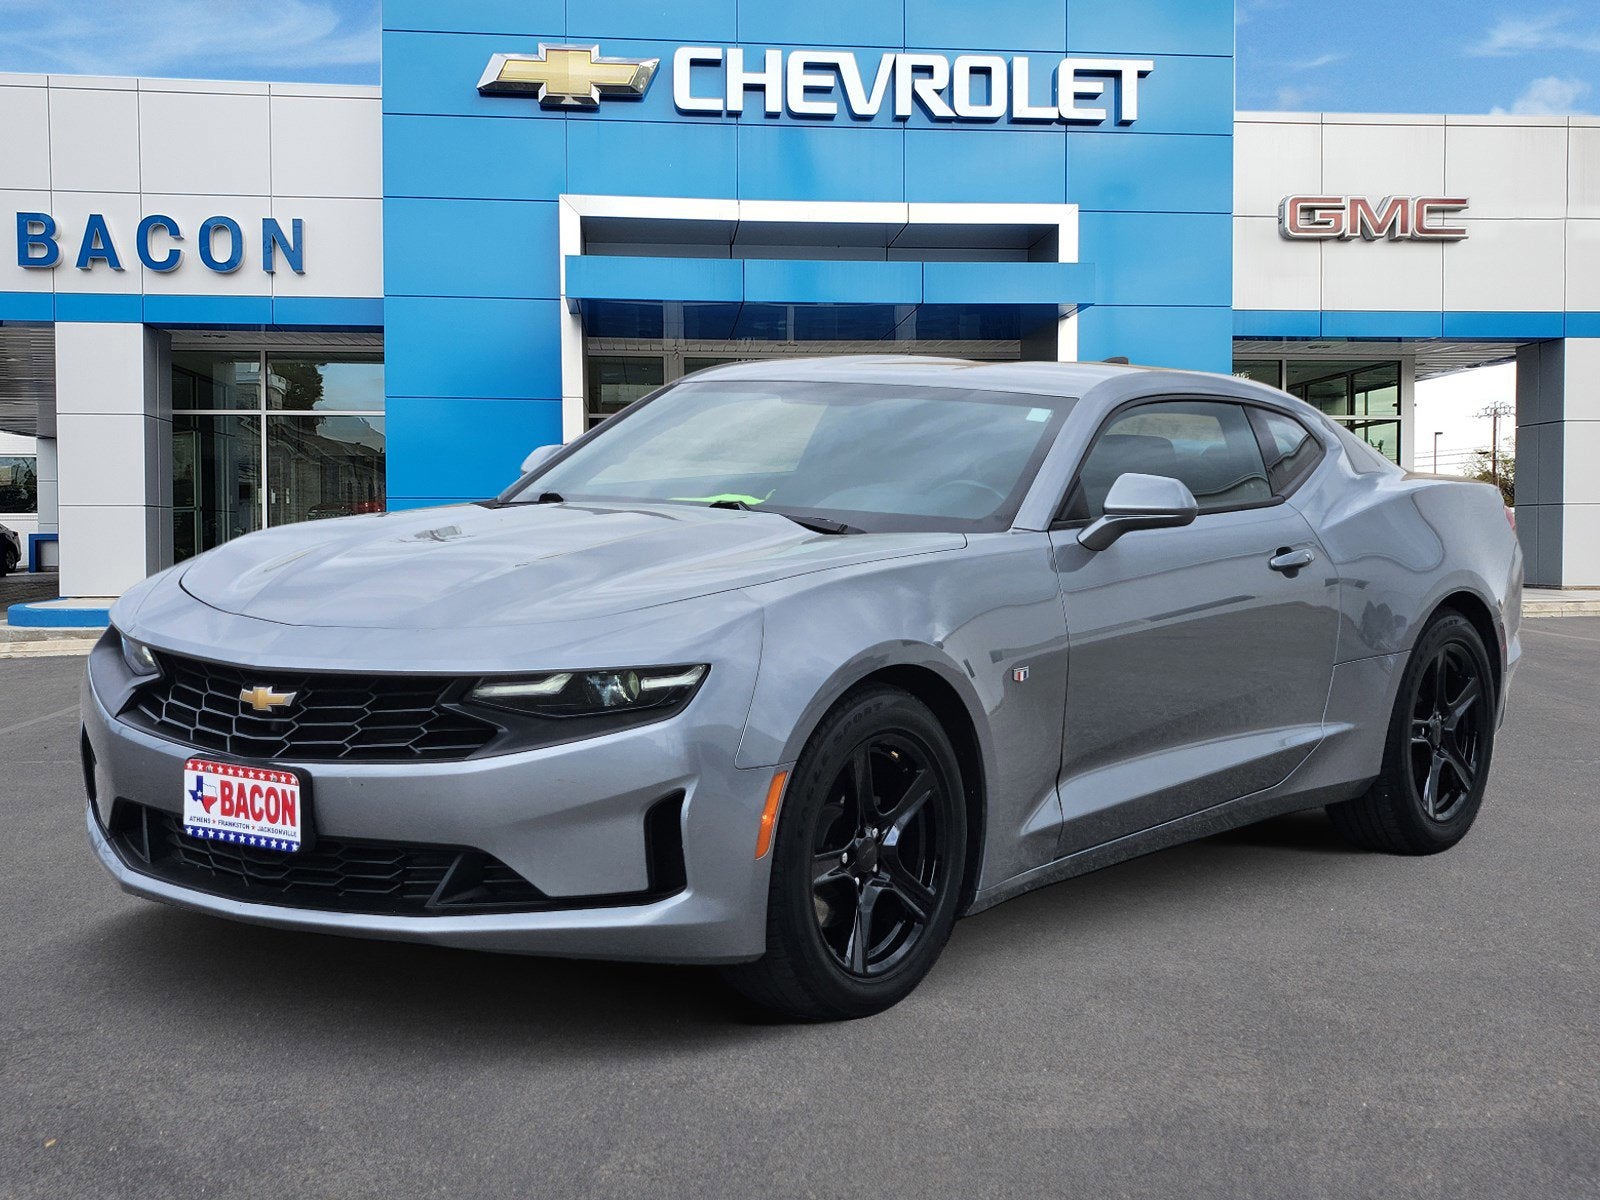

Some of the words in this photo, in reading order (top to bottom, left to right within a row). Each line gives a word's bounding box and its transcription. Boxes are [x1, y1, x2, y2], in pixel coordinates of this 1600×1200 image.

[673, 46, 1154, 126] CHEVROLET
[1279, 194, 1470, 241] GMC
[16, 211, 307, 275] BACON
[188, 815, 211, 825] ATHENS
[218, 819, 250, 830] FRANKSTON
[257, 827, 297, 838] JACKSONVILLE
[220, 779, 297, 827] BACON
